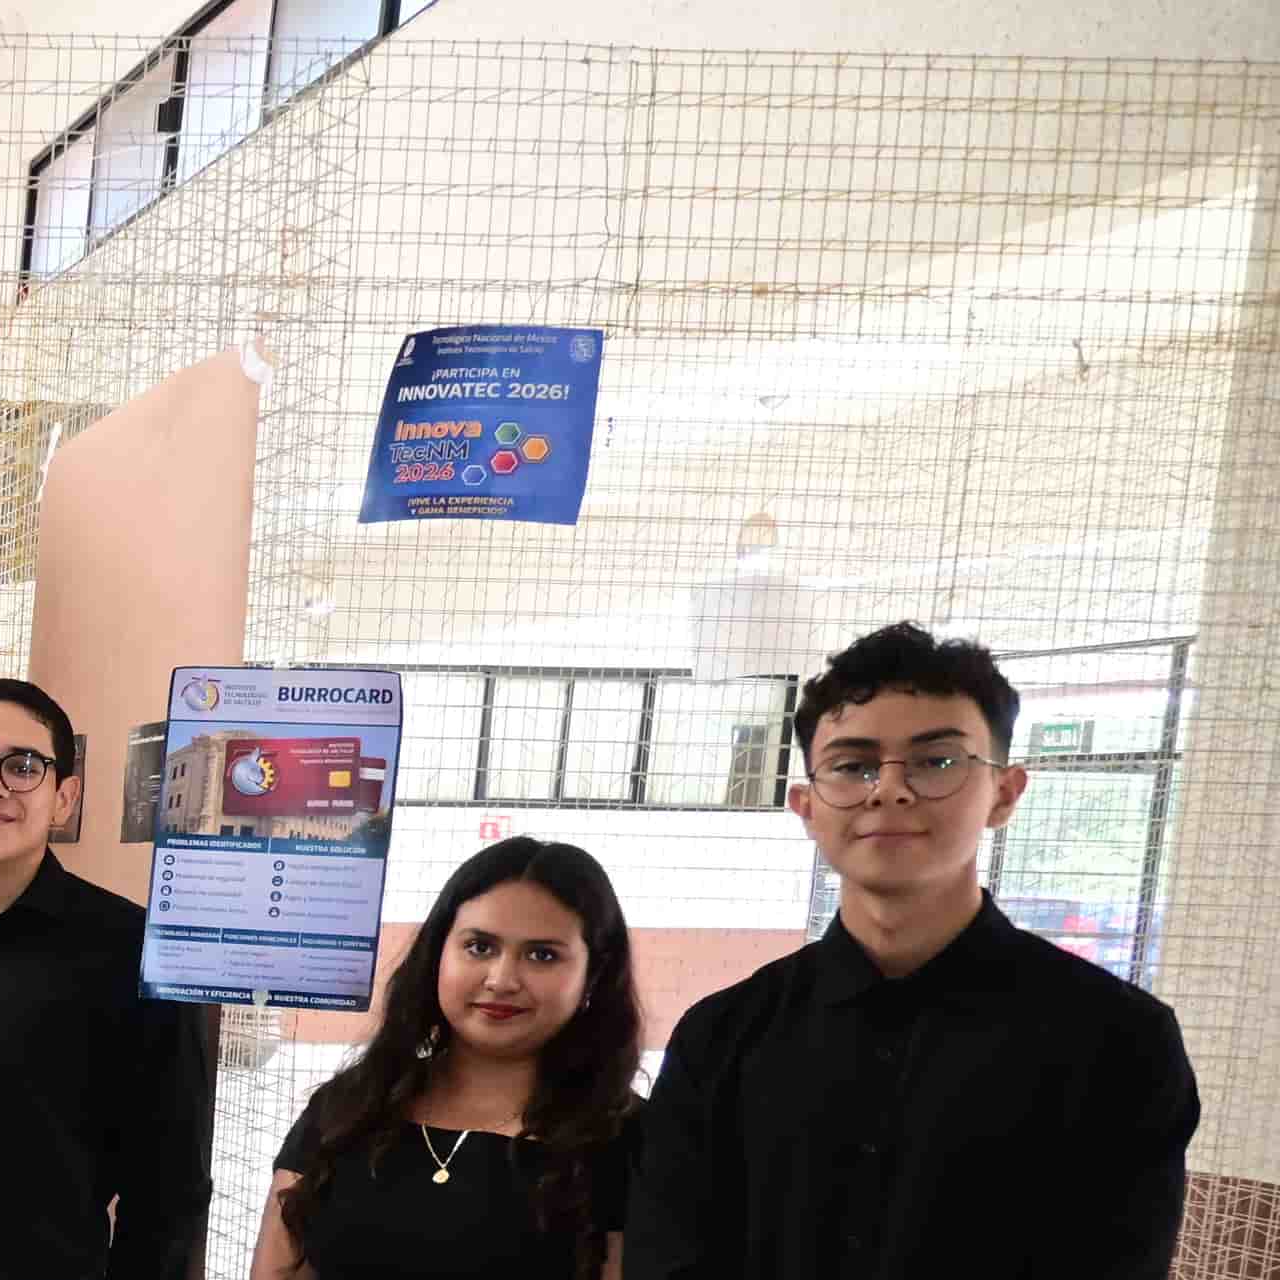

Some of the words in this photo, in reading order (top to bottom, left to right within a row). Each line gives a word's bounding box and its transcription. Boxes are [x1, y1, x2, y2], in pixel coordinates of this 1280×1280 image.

[432, 367, 498, 381] ¡PARTICIPA
[502, 367, 520, 378] EN
[397, 383, 501, 402] INNOVATEC
[509, 383, 569, 400] 2026!
[394, 419, 482, 441] Innova
[389, 440, 470, 463] TecNM
[393, 462, 455, 484] 2026
[433, 497, 447, 505] LA
[277, 686, 393, 704] BURROCARD
